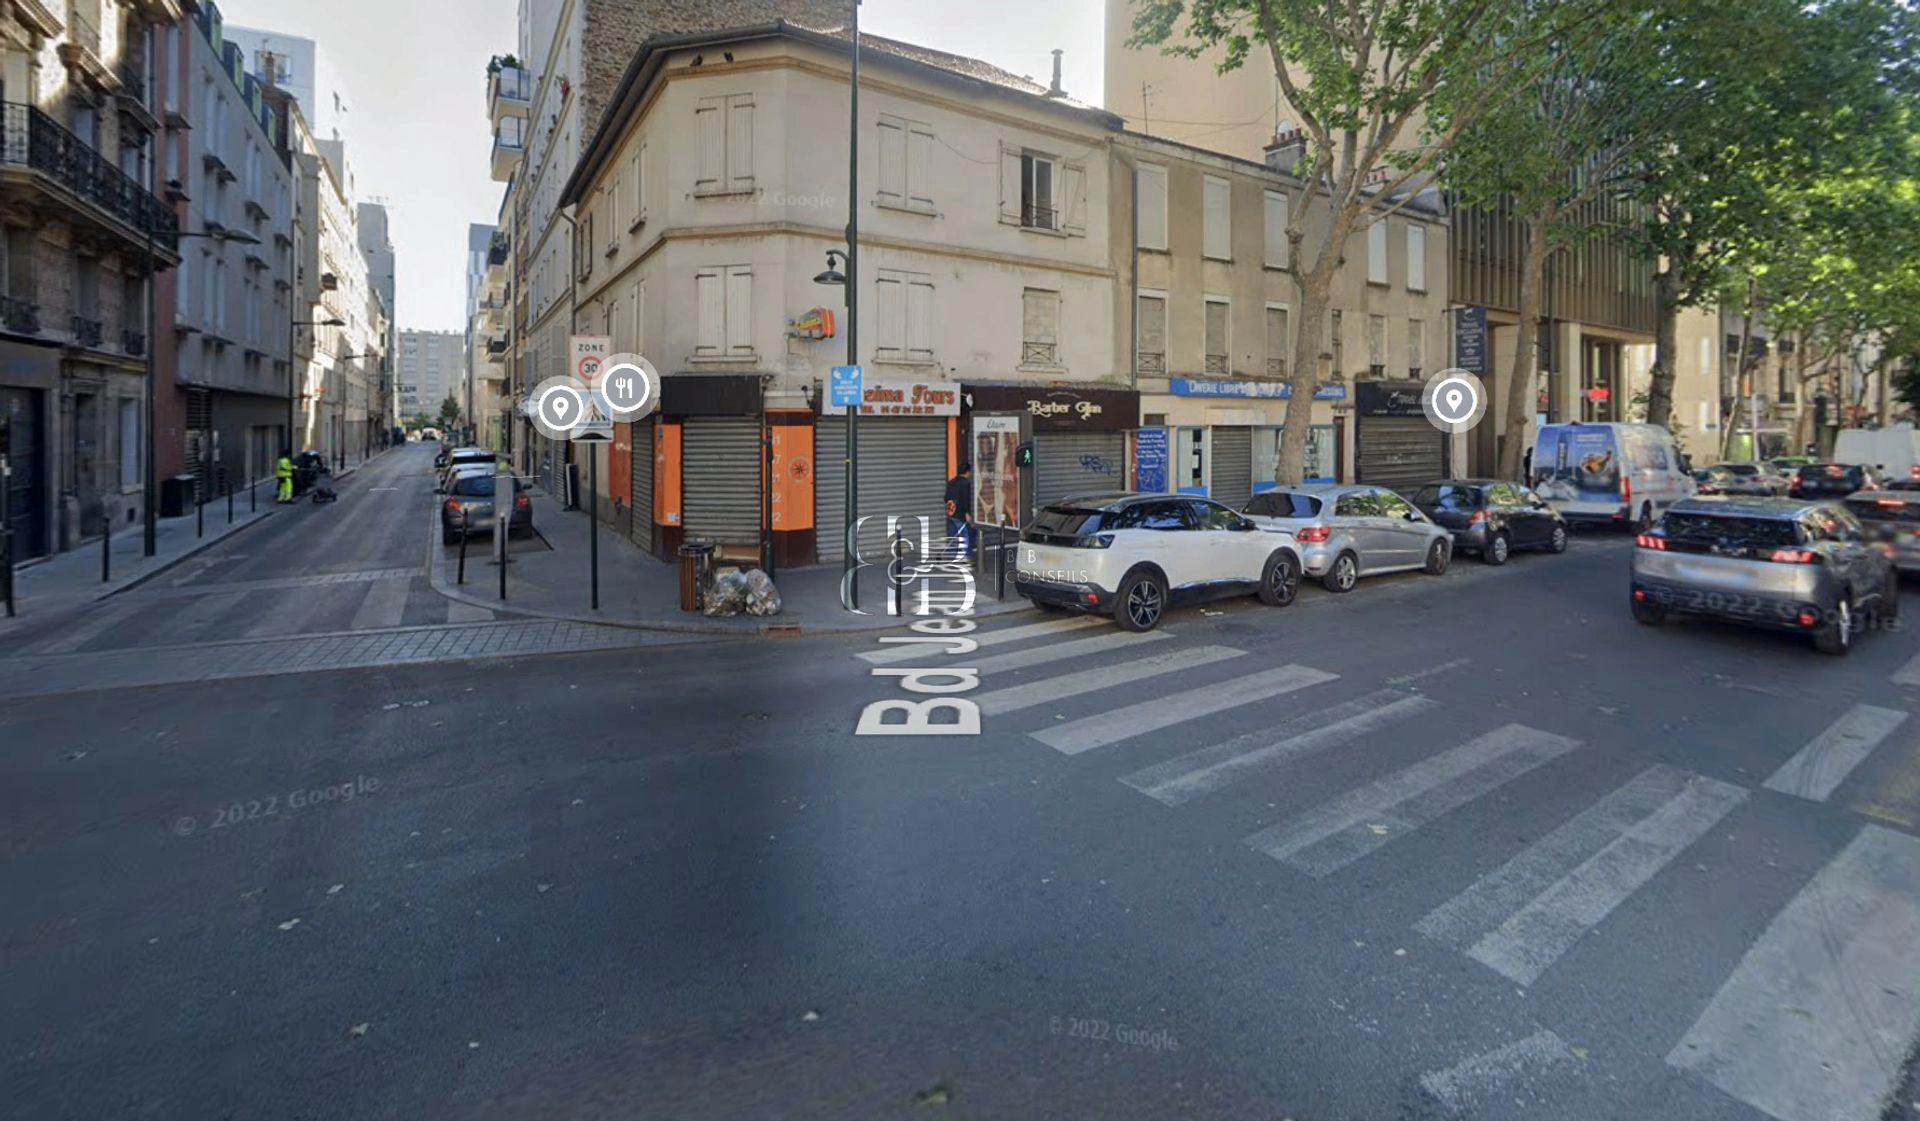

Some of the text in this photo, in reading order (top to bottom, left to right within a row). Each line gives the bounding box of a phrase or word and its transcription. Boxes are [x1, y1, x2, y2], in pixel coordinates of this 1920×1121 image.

[578, 344, 604, 352] ZONE
[584, 363, 598, 374] 30
[912, 384, 955, 405] Tours
[1026, 400, 1071, 418] Barber
